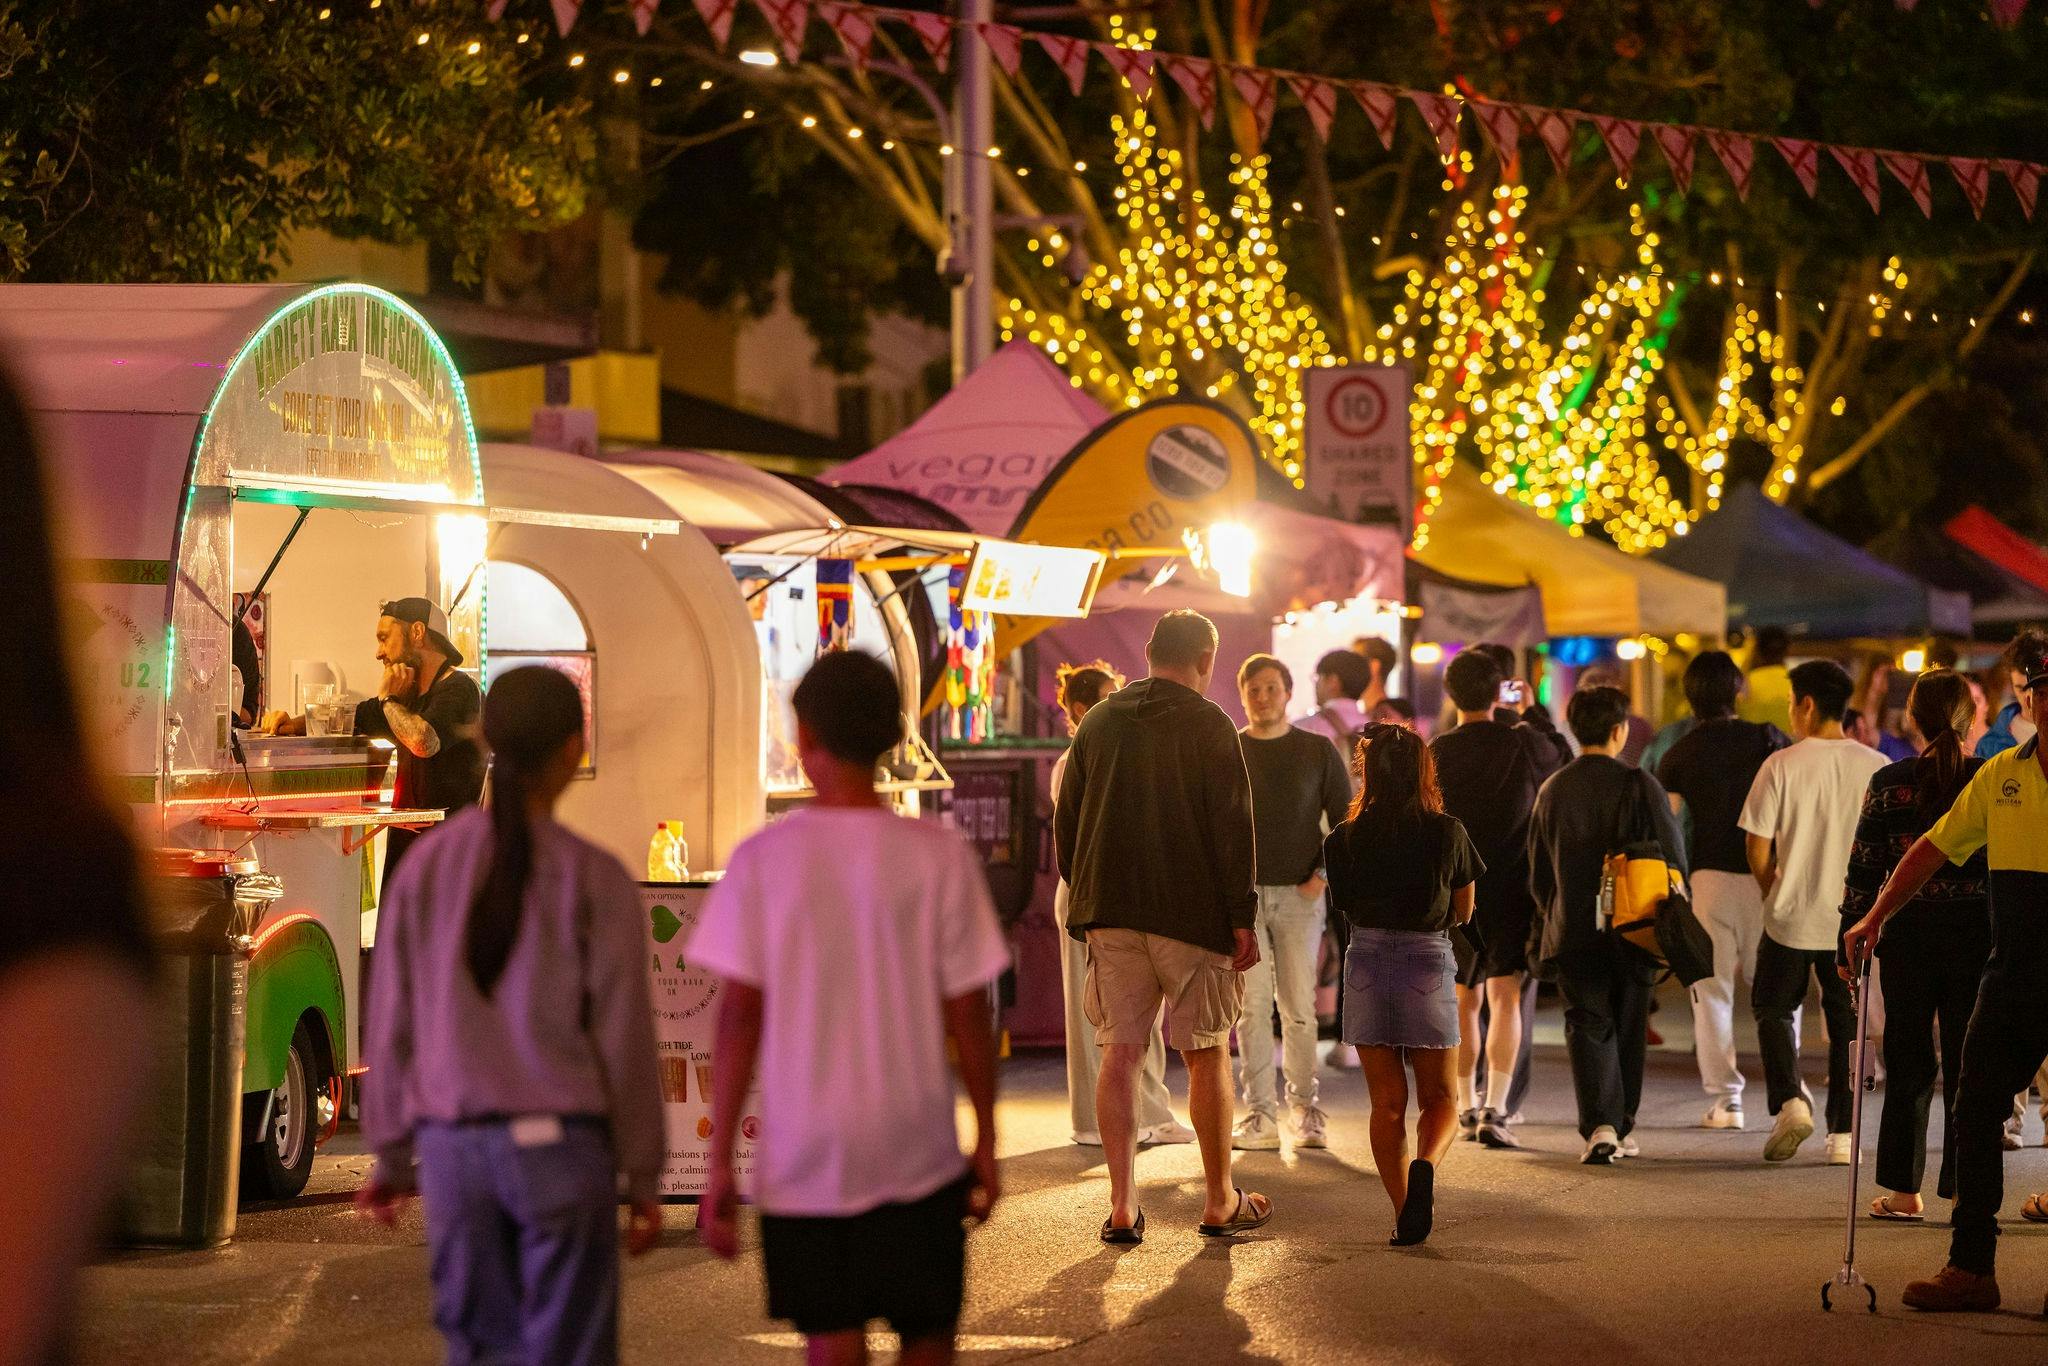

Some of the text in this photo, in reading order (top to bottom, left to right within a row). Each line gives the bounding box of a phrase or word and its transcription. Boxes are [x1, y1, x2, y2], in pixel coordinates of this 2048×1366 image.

[254, 296, 437, 401] VARIETY KAVA INFUSIONS
[1343, 392, 1374, 422] 10
[283, 391, 312, 435] COME
[315, 393, 334, 436] GET
[335, 396, 361, 439] YOUR
[683, 978, 703, 986] KAVA
[674, 1041, 694, 1050] TIDE
[691, 1052, 712, 1061] LOW
[672, 1181, 709, 1191] pleasant
